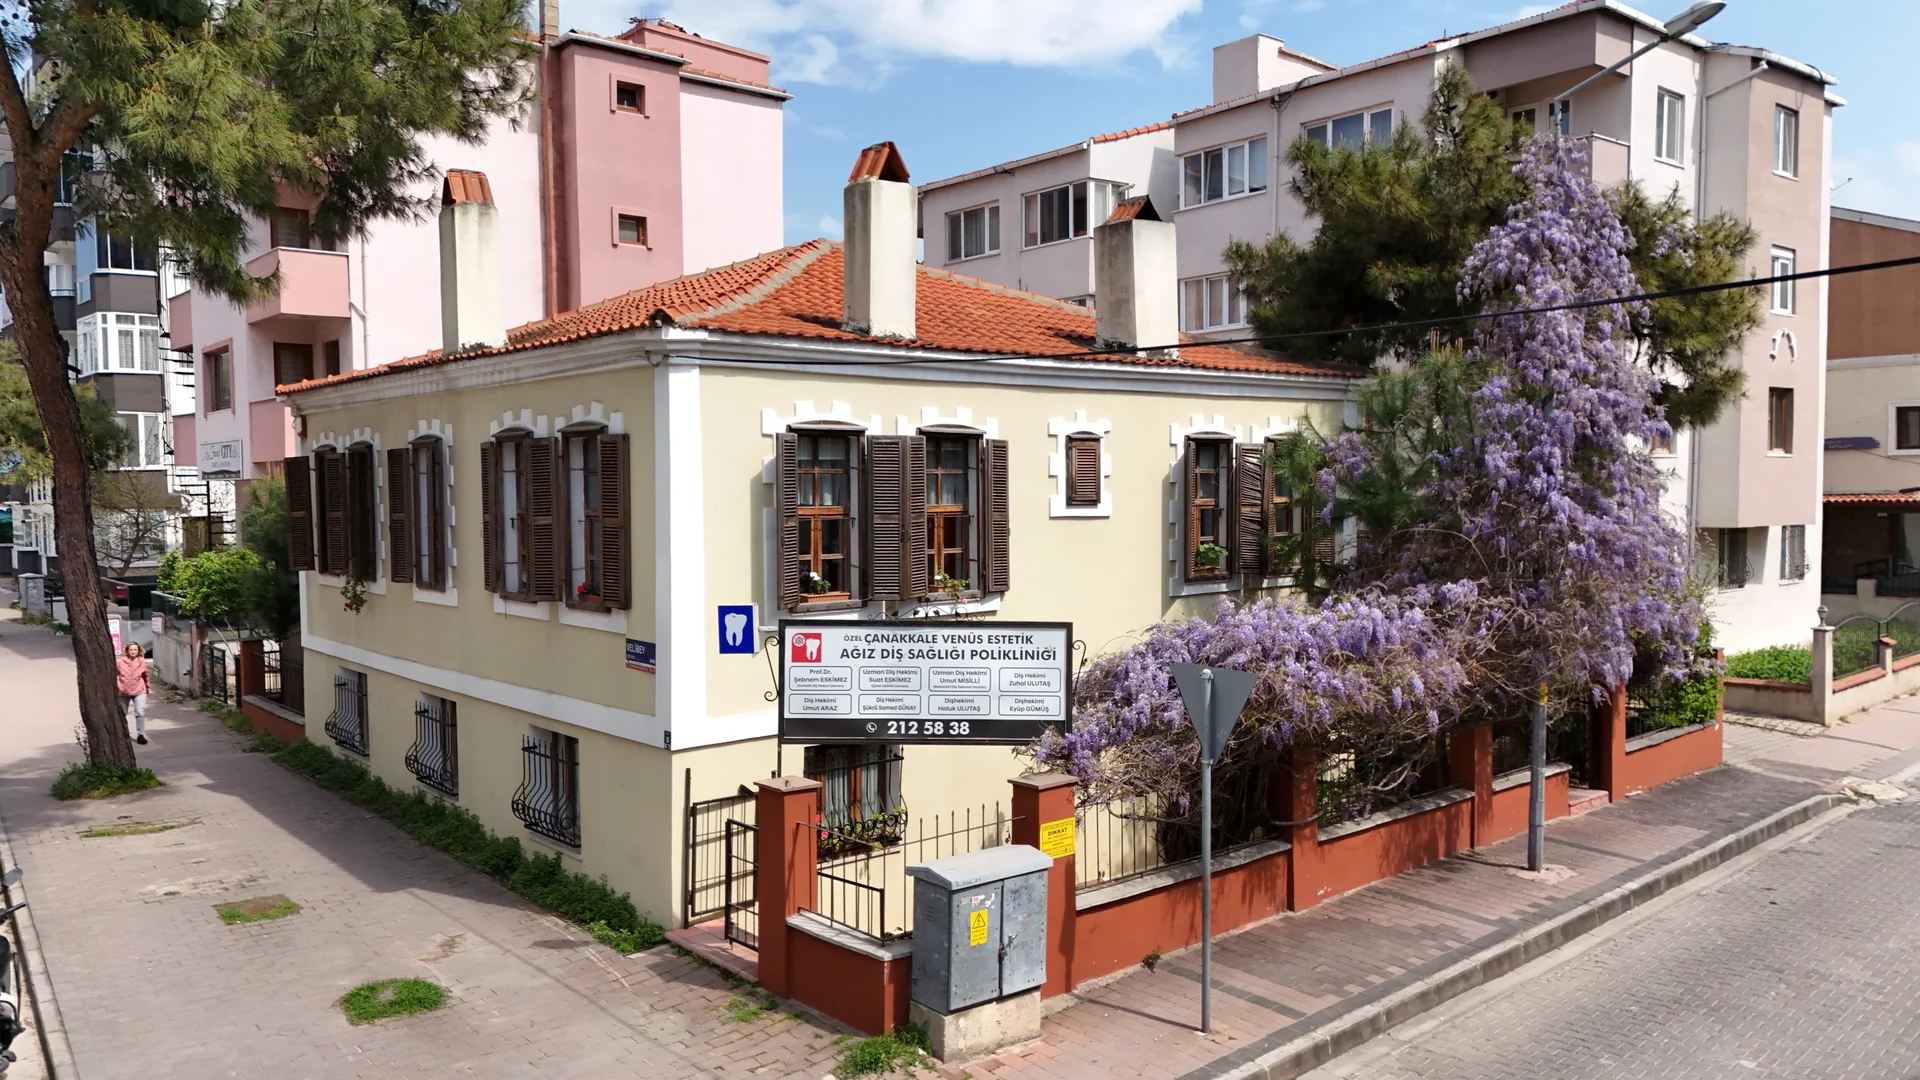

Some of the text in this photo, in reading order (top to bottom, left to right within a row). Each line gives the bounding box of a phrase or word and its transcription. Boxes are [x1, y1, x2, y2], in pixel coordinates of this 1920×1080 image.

[843, 631, 1034, 646] ÖZEL ÇANAKKALE VENÜS ESTETİK
[840, 645, 1056, 662] AĞIZ DİŞ SAĞLIĞI POLİKLİNİĞİ
[885, 668, 895, 676] Diş
[1025, 705, 1050, 713] GÜMÜŞ
[887, 721, 970, 735] 212 58 38
